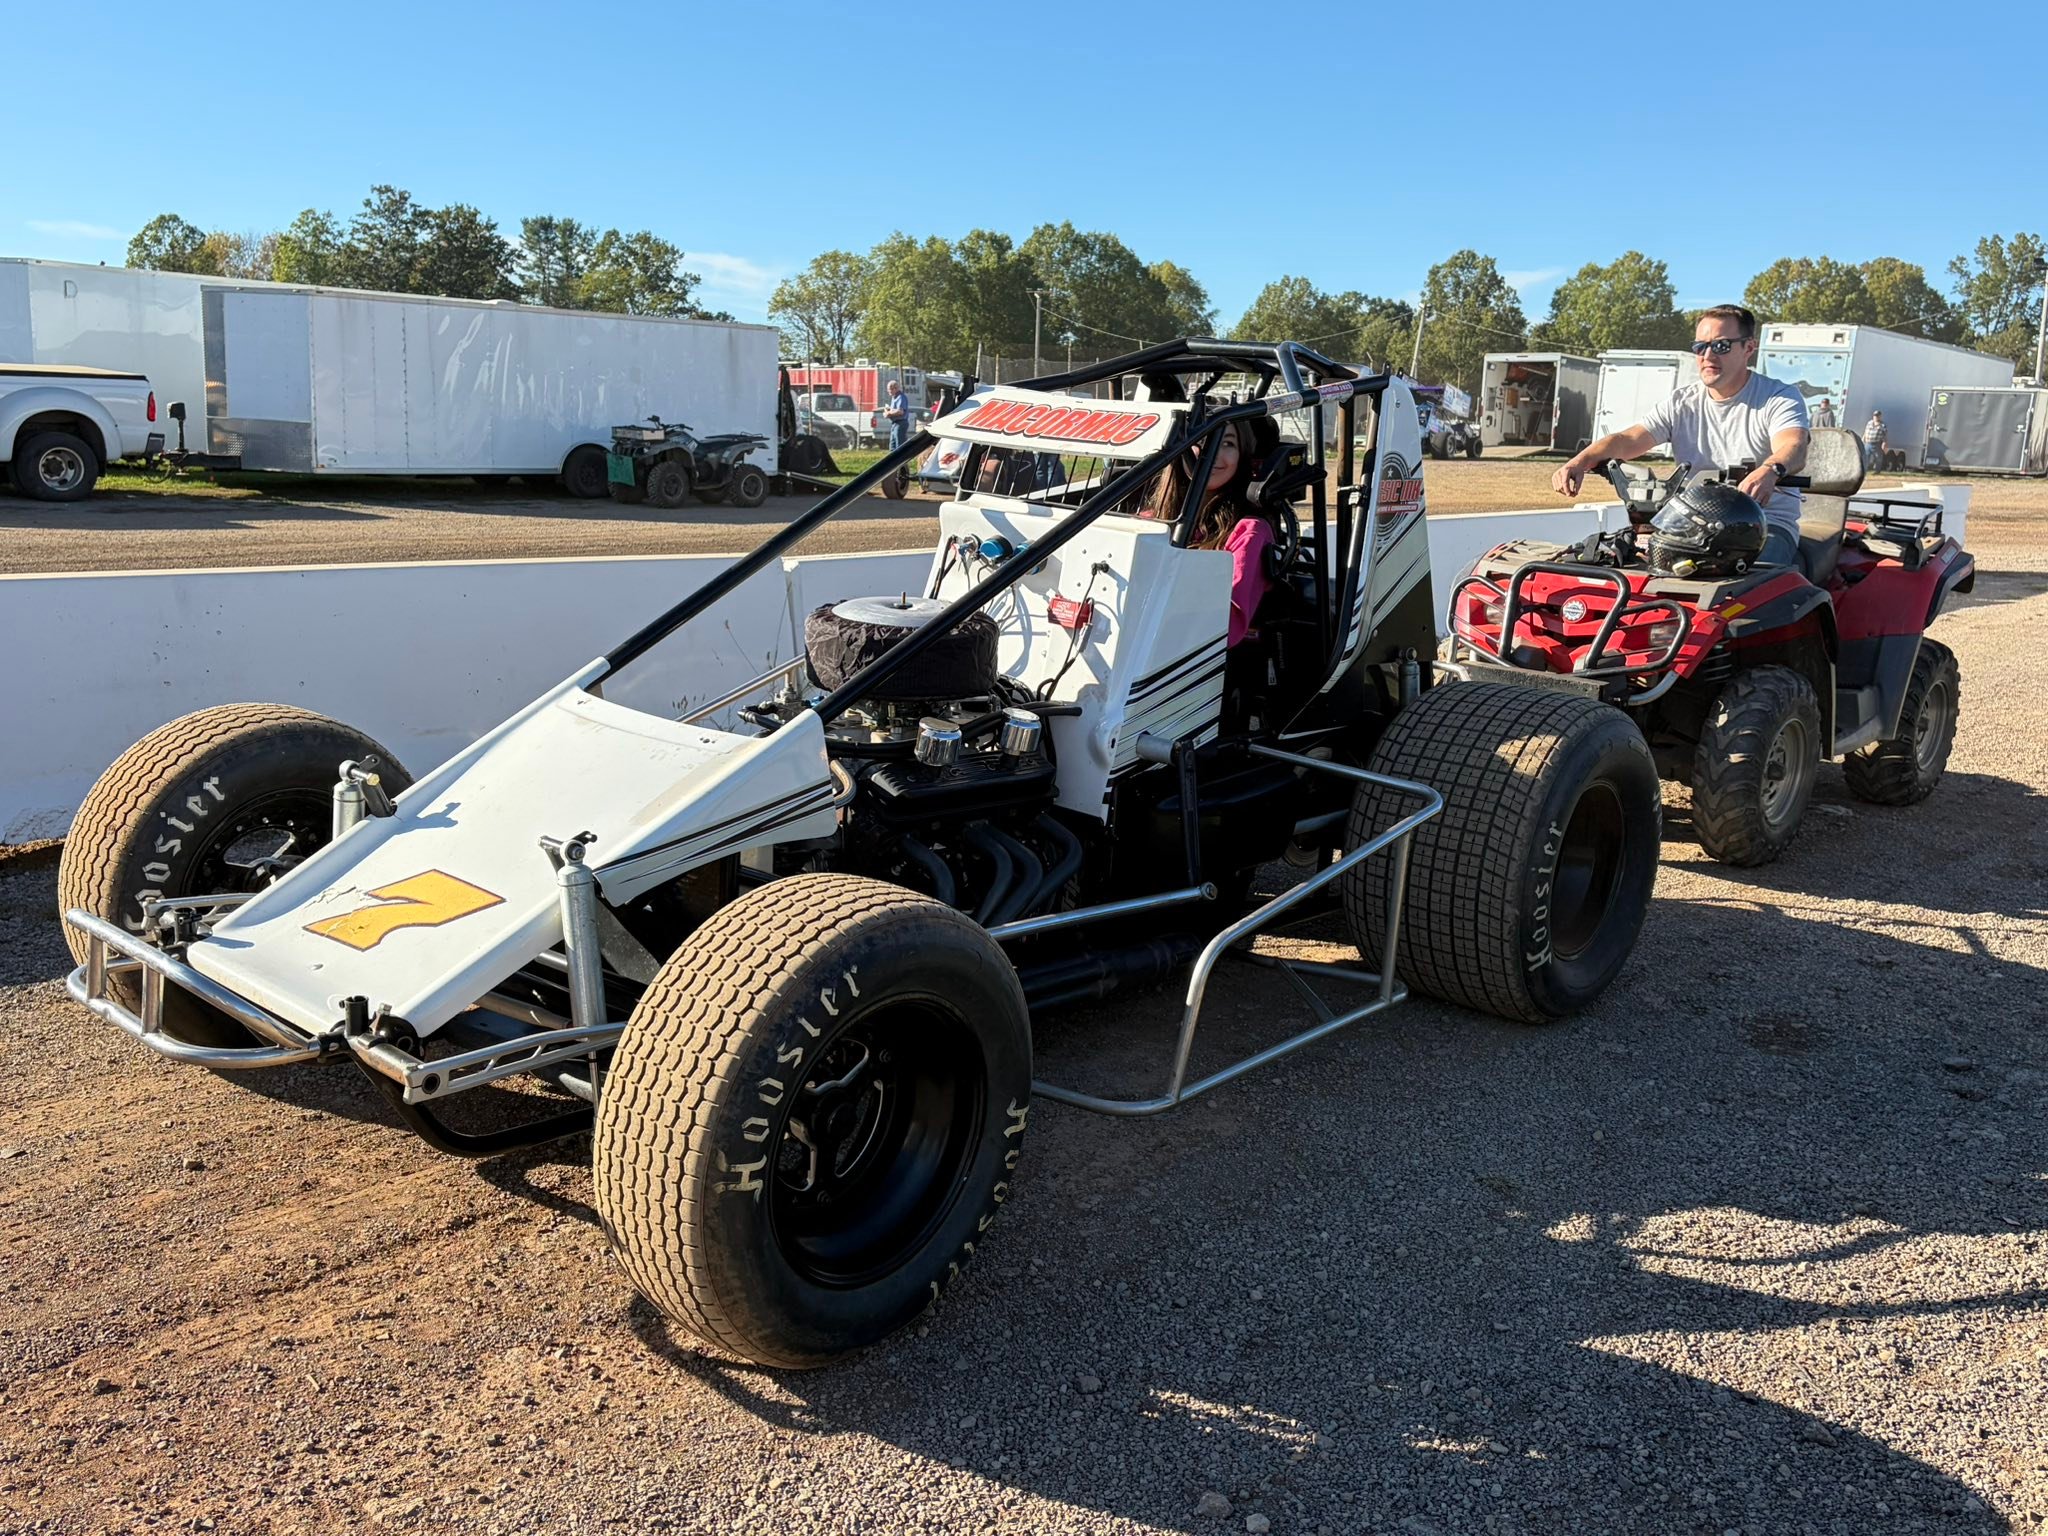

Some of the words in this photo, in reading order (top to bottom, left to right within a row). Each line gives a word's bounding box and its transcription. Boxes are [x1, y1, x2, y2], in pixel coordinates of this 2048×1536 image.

[955, 398, 1160, 446] MACORMAC
[124, 776, 225, 931] oosier
[1526, 821, 1564, 972] Hoosier
[715, 965, 859, 1205] Hoosier
